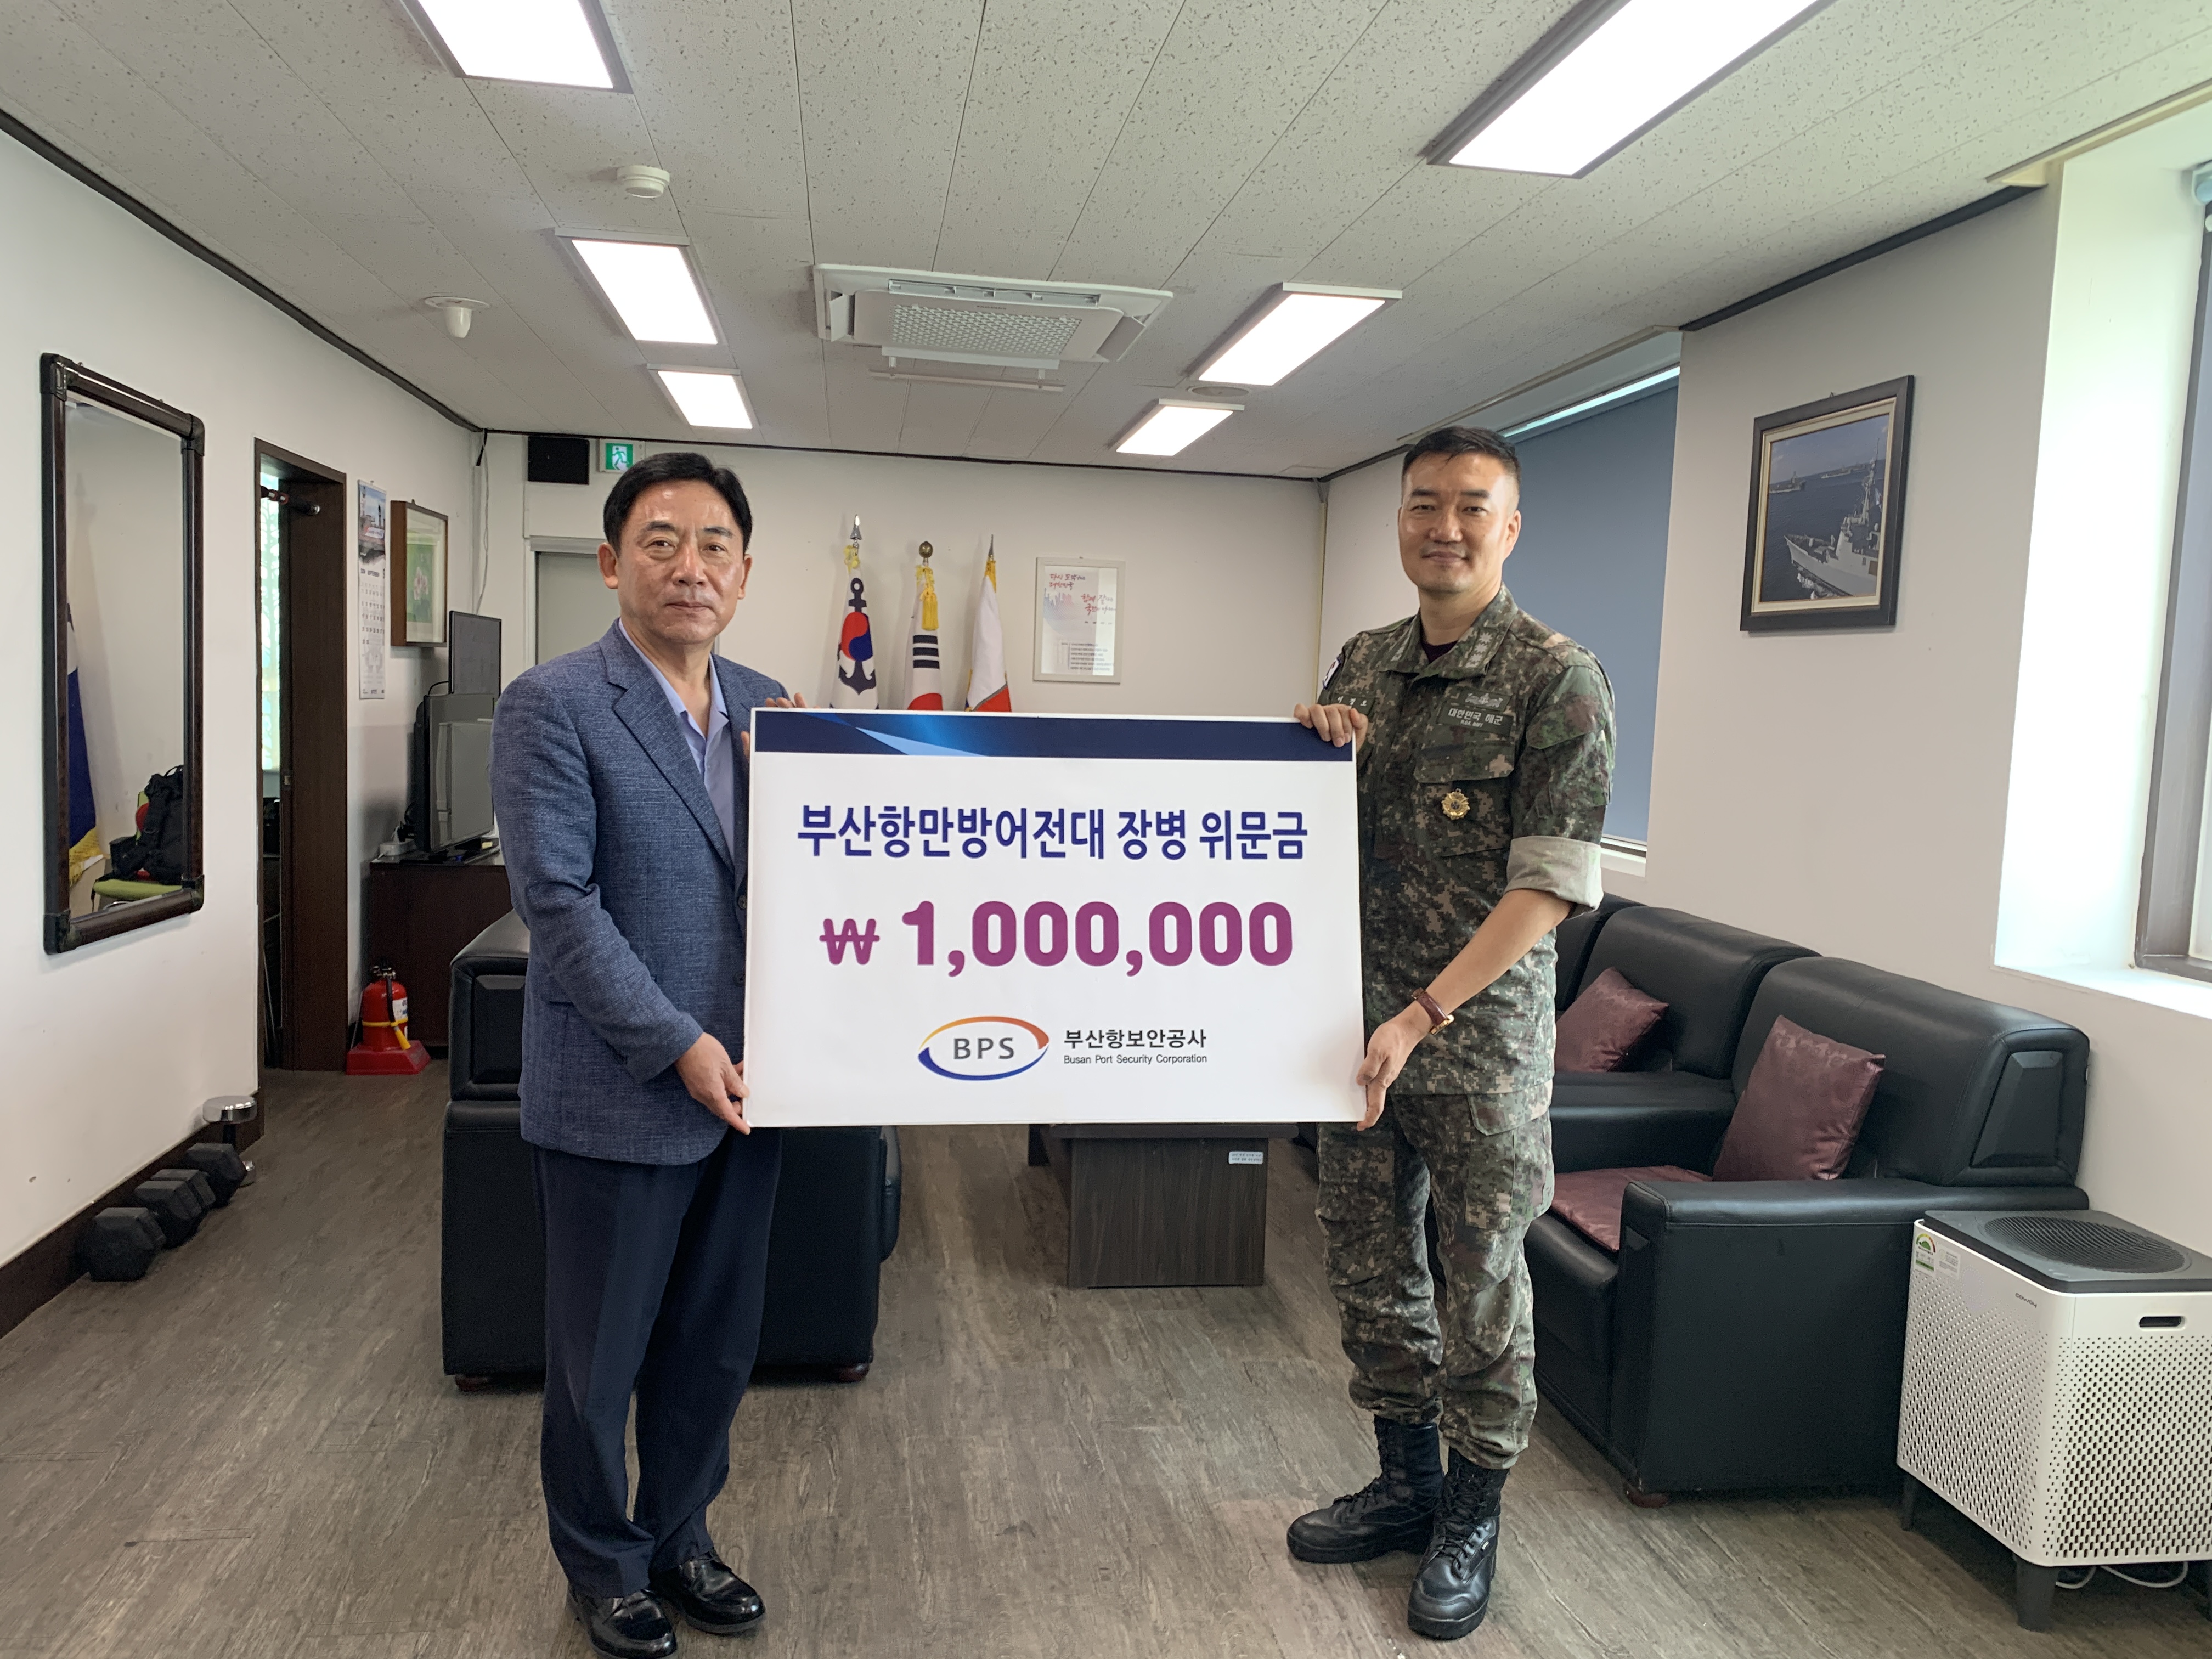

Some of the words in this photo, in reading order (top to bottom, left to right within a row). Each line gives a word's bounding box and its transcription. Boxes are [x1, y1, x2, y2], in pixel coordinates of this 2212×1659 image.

[1448, 708, 1482, 721] 대한민국
[1485, 714, 1503, 726] 해군
[797, 805, 1105, 860] 부산항만방어전대
[1116, 809, 1187, 860] 장병
[1199, 810, 1308, 860] 위문금
[902, 900, 1293, 977] 1,000,000
[953, 1037, 1014, 1059] BPS
[1064, 1029, 1206, 1049] 부산항보안공사
[1064, 1055, 1091, 1064] Busan
[1095, 1055, 1113, 1064] Port
[1116, 1054, 1152, 1065] Security
[1156, 1054, 1207, 1064] Corporation
